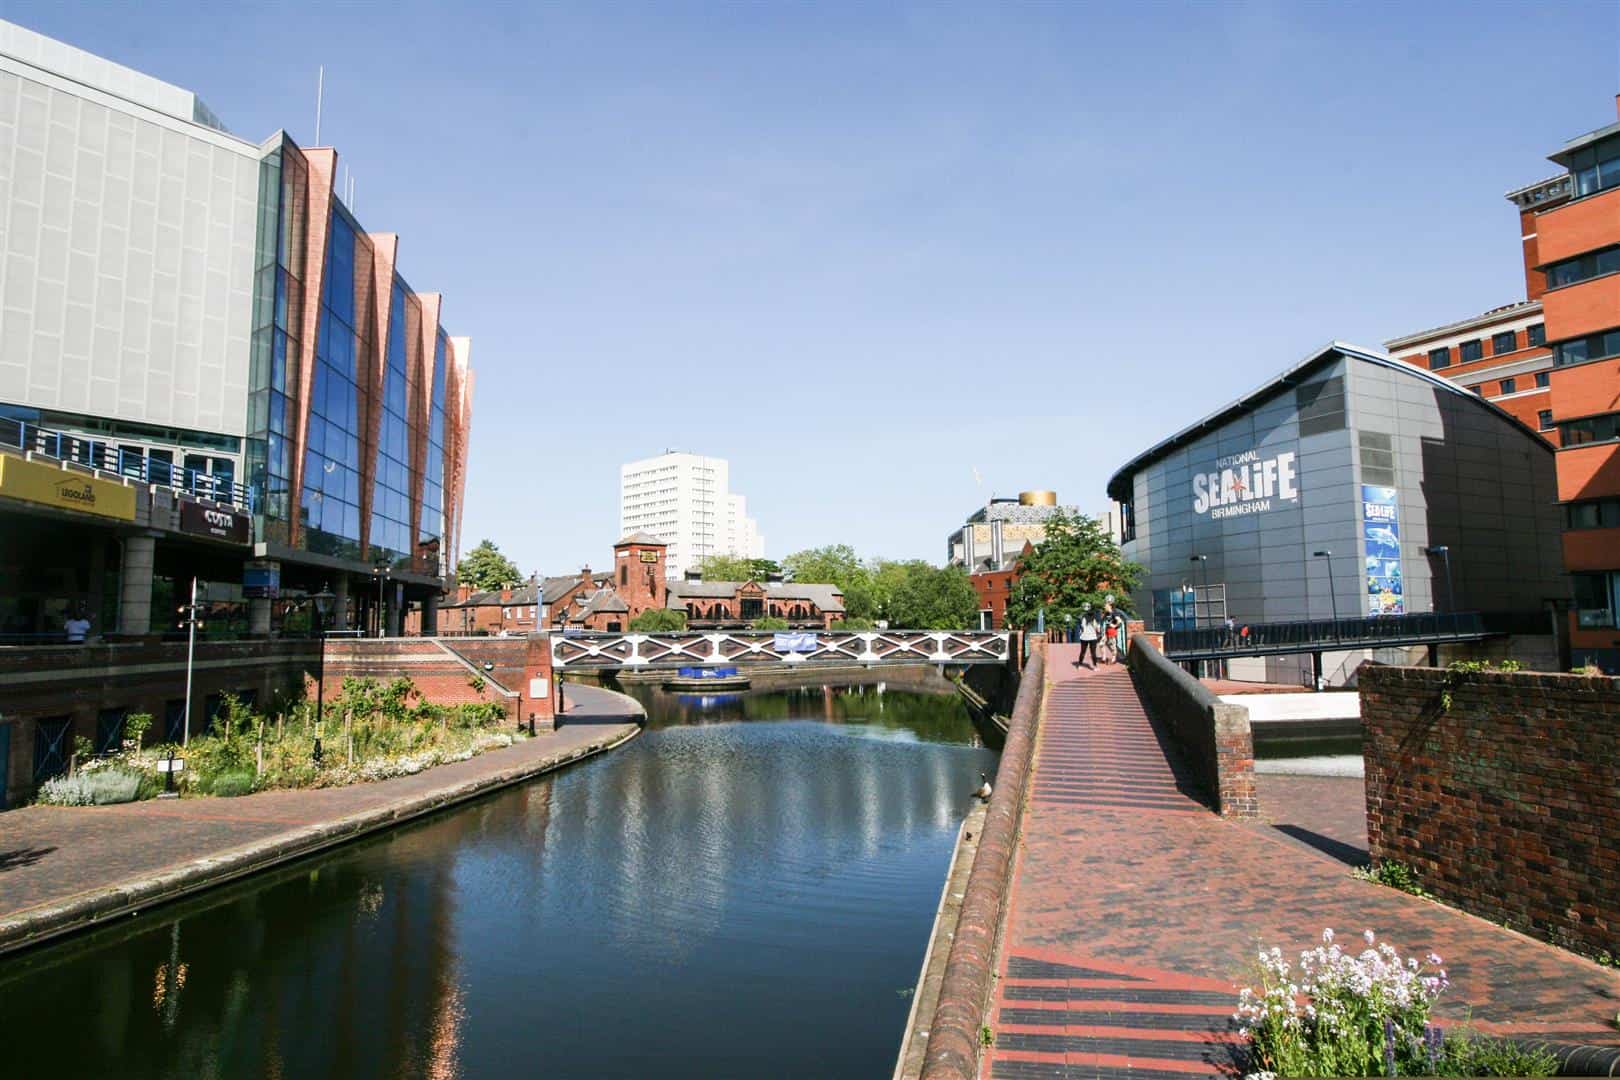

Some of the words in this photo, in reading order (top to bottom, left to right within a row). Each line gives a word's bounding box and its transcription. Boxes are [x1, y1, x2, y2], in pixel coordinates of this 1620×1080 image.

[1216, 450, 1260, 469] NATIONAL
[61, 487, 96, 502] LEGOLAND
[1211, 500, 1270, 519] BIRMINGHAM
[205, 510, 233, 528] COSTA
